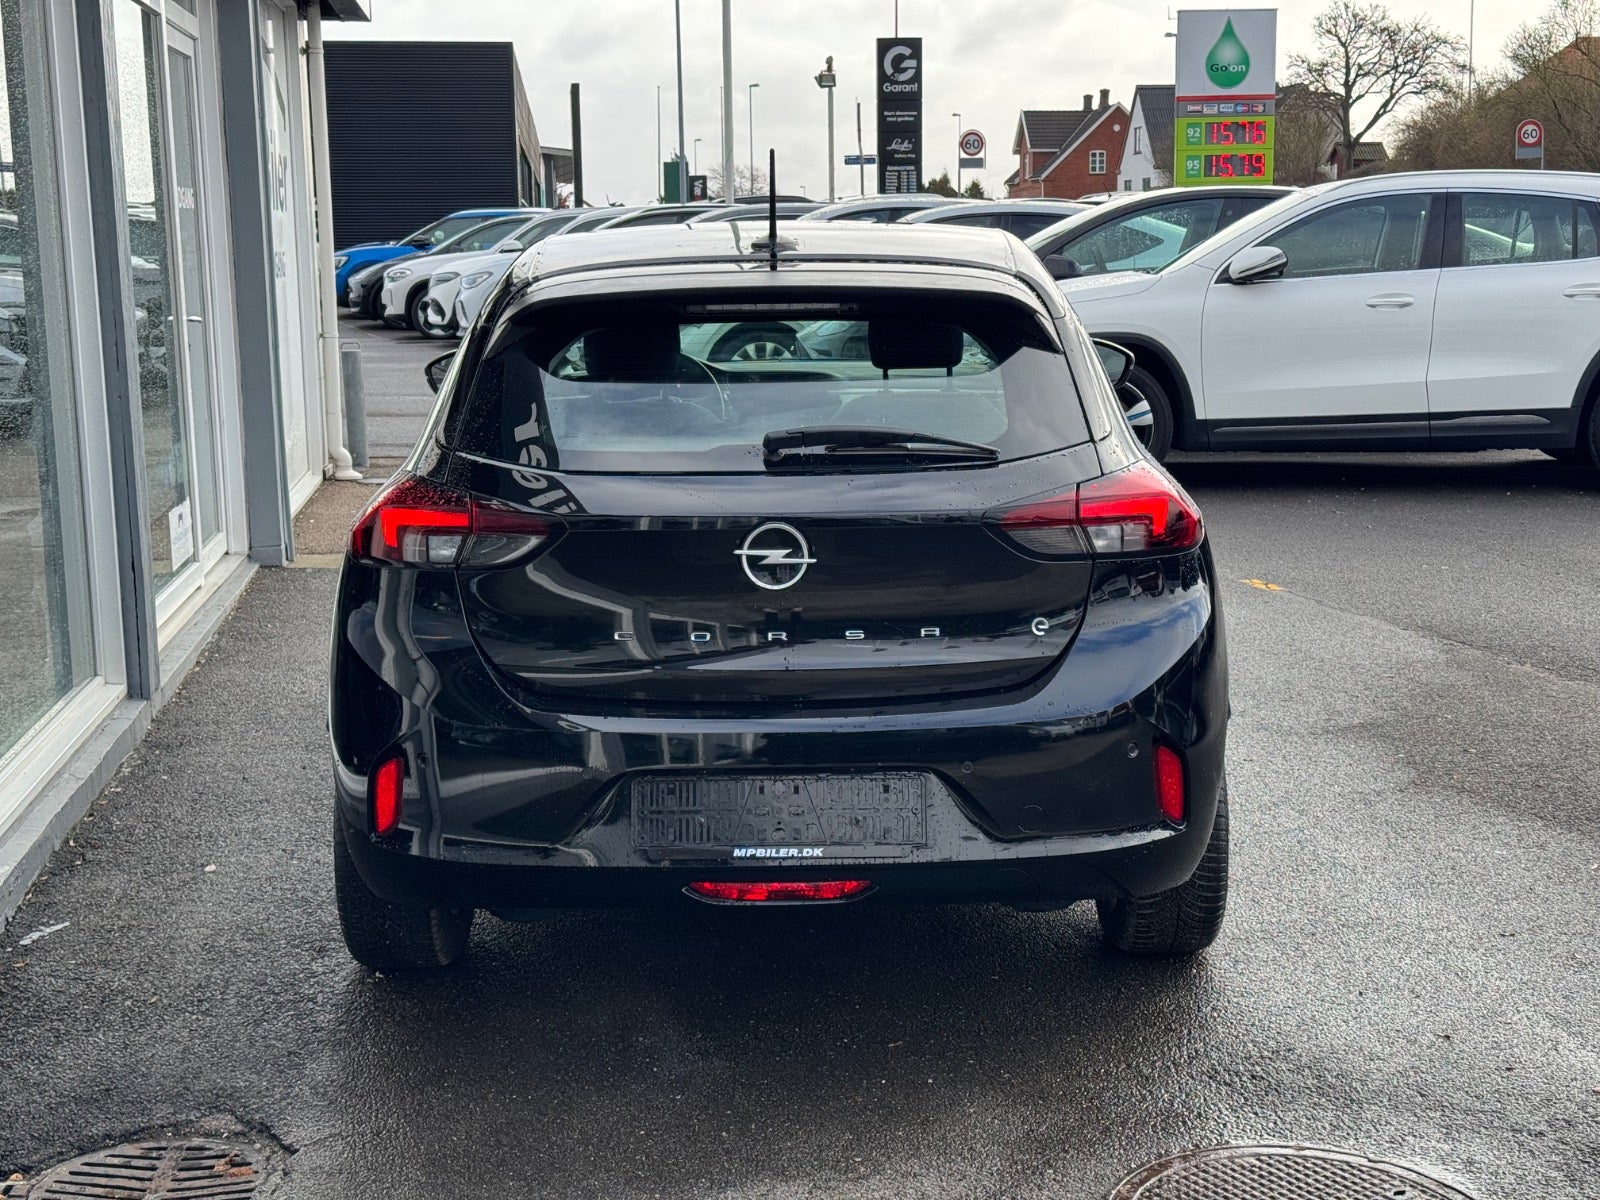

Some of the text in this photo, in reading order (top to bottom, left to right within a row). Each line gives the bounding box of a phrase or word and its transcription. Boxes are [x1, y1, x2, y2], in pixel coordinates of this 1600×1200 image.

[883, 82, 918, 92] Garant
[1187, 128, 1201, 137] 92
[1523, 129, 1538, 139] 60
[964, 139, 980, 149] 60
[1186, 153, 1265, 177] 95 15.79
[614, 627, 940, 641] CORSA
[733, 847, 824, 857] MPBILER.DK
